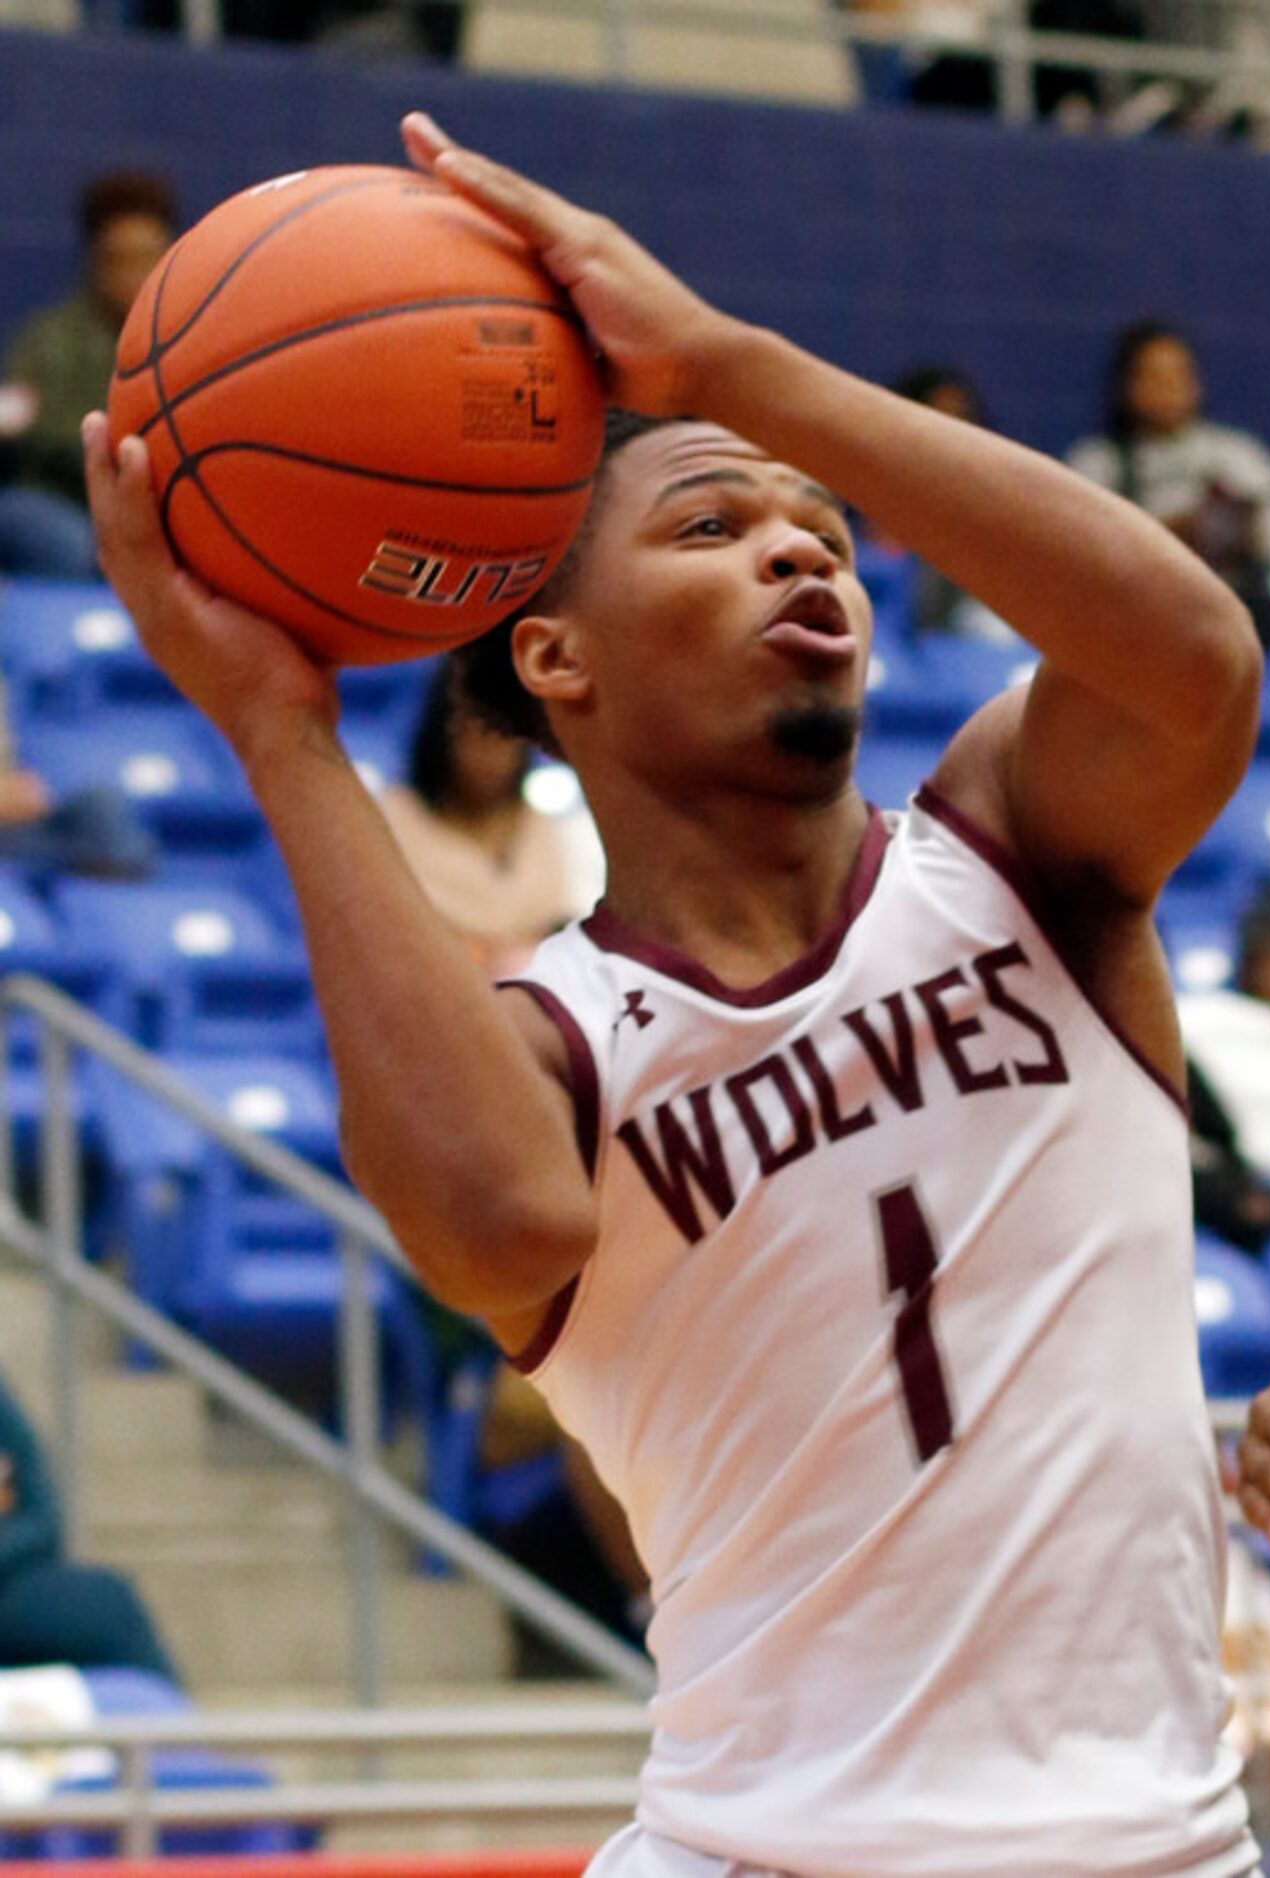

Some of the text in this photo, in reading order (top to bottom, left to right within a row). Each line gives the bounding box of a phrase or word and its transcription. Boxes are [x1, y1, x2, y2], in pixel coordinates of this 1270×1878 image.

[359, 541, 548, 605] ELITE
[615, 942, 1069, 1246] WOLVES
[872, 1177, 956, 1465] 1
